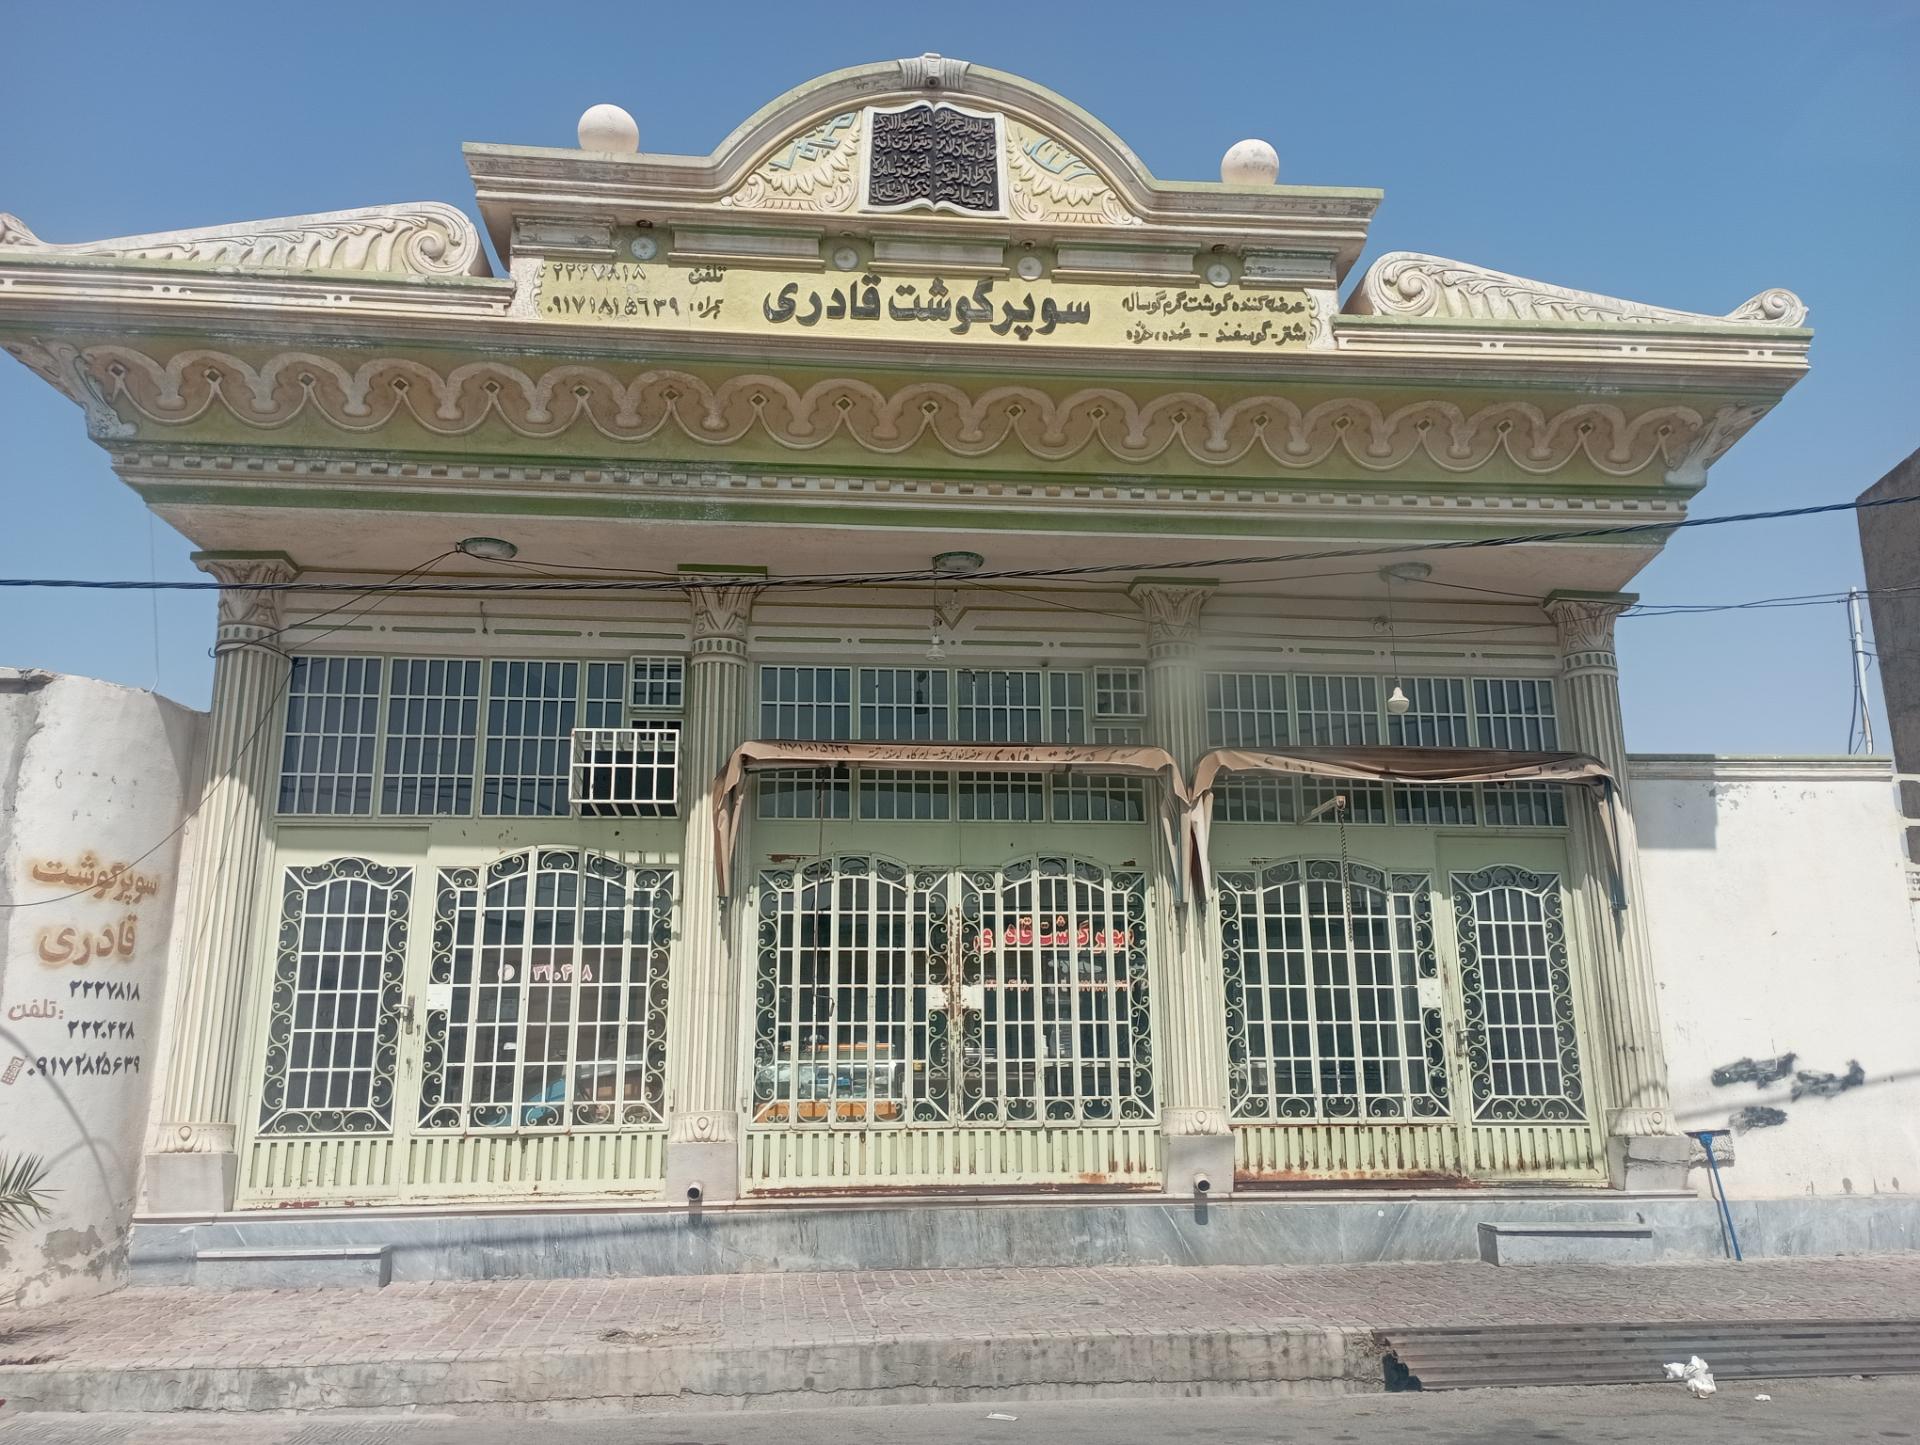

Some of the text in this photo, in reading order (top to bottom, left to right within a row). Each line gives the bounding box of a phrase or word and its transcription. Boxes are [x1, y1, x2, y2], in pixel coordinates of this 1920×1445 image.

[688, 264, 728, 285] تلفن
[763, 273, 882, 326] قادری
[1121, 290, 1306, 317] عرضه کننده گوشت گرم گوساله
[1215, 320, 1273, 346] گوسفند
[1275, 322, 1307, 346] شتر
[38, 913, 138, 965] قادری
[69, 979, 141, 1001] ۲۲۲۷۸۱۸
